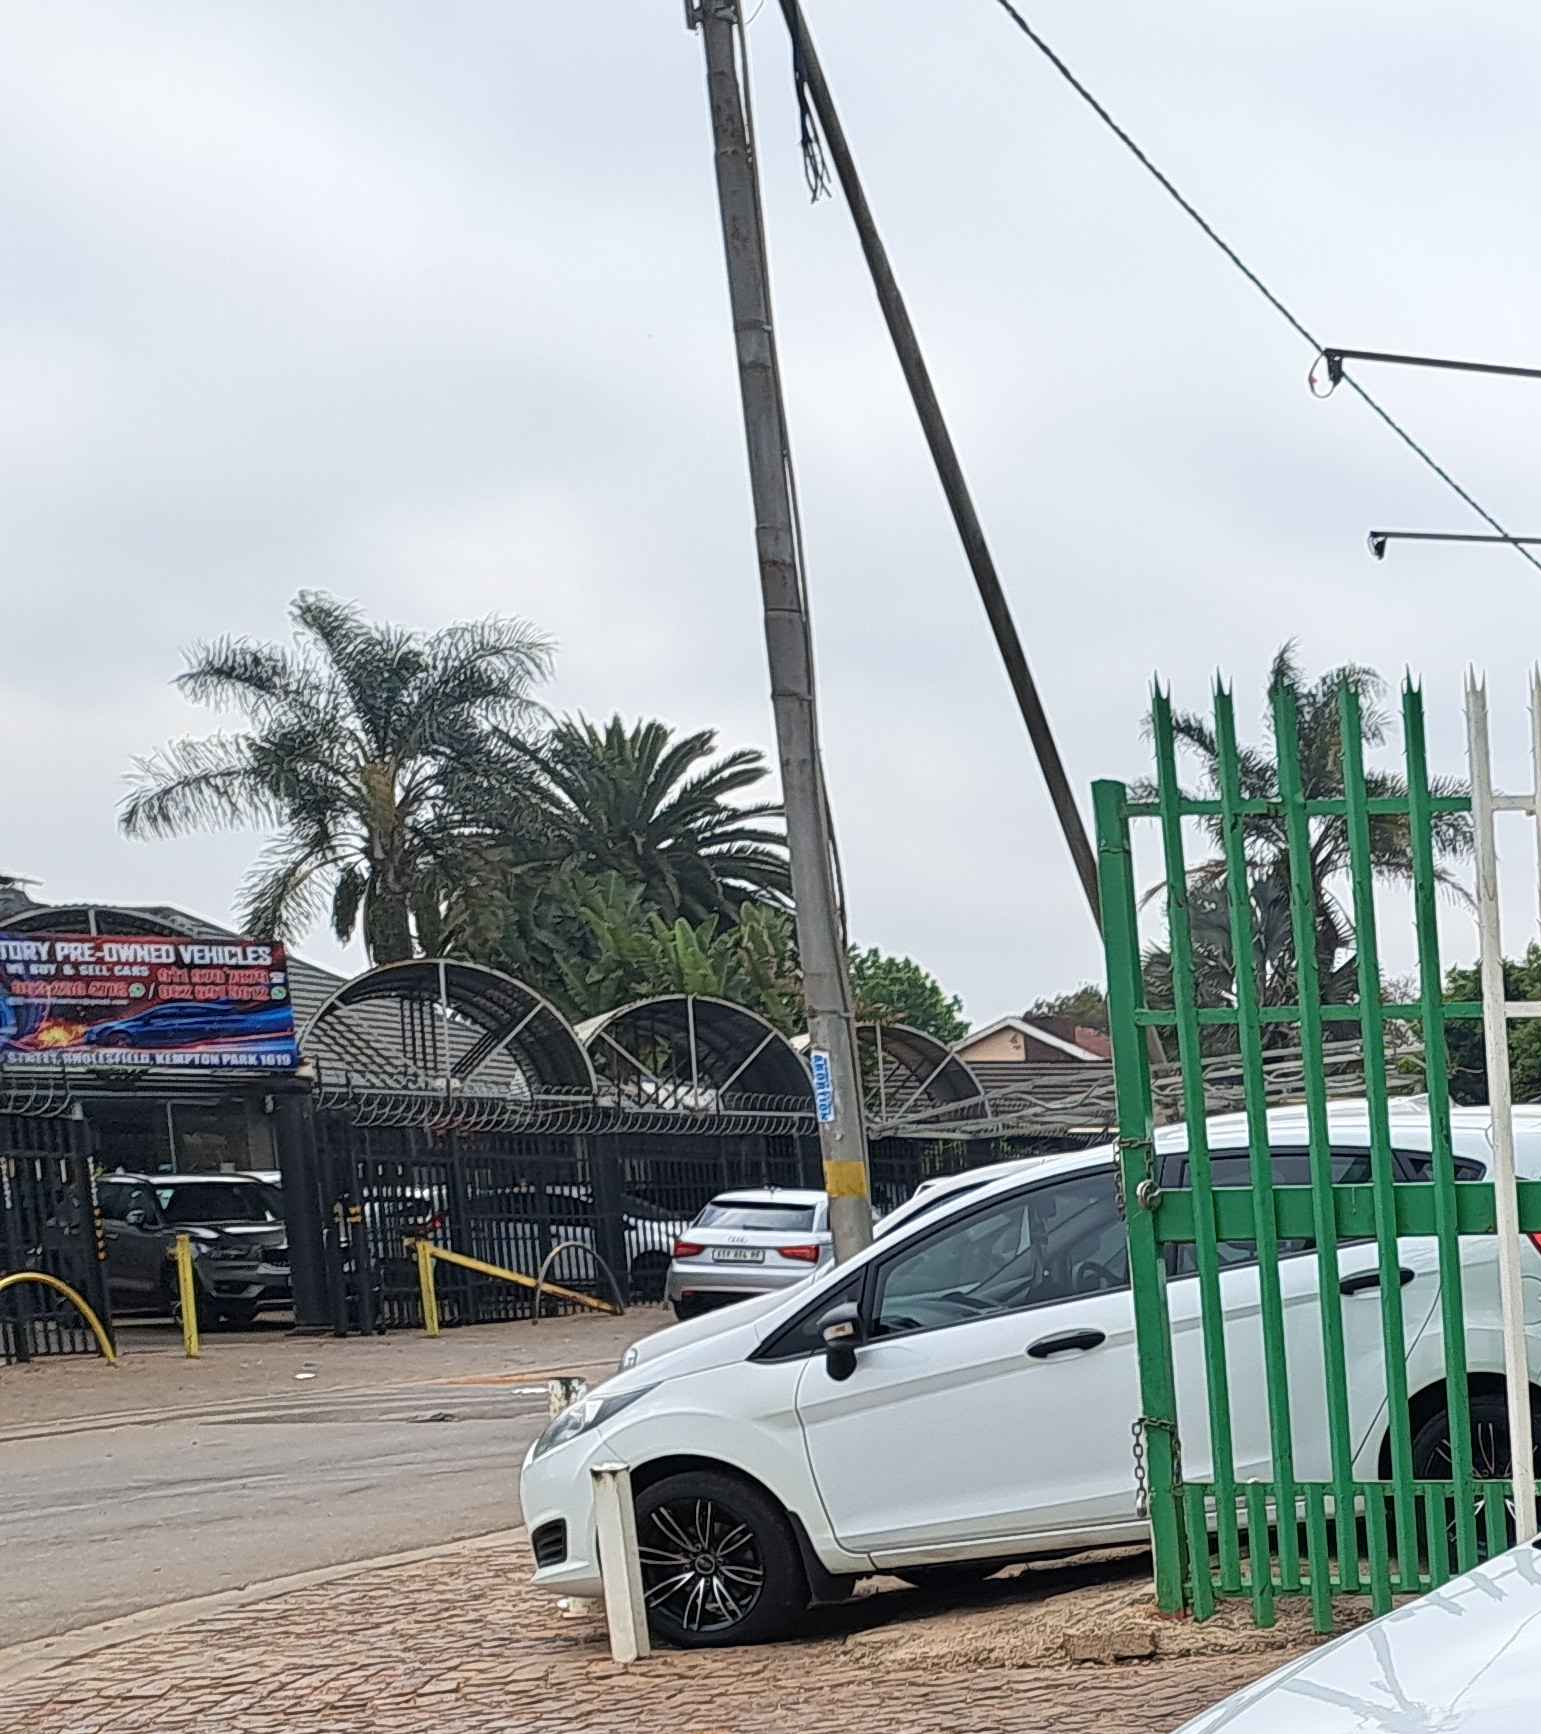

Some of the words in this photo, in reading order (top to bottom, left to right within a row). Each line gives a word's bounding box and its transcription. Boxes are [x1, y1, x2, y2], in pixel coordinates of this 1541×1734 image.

[56, 942, 176, 963] PRE-OWNED
[178, 944, 272, 966] VEHICLES
[29, 964, 57, 976] BUY
[79, 965, 111, 977] SELL
[113, 966, 150, 977] CARS
[155, 1054, 219, 1067] KEMPTON
[221, 1054, 259, 1067] PARK
